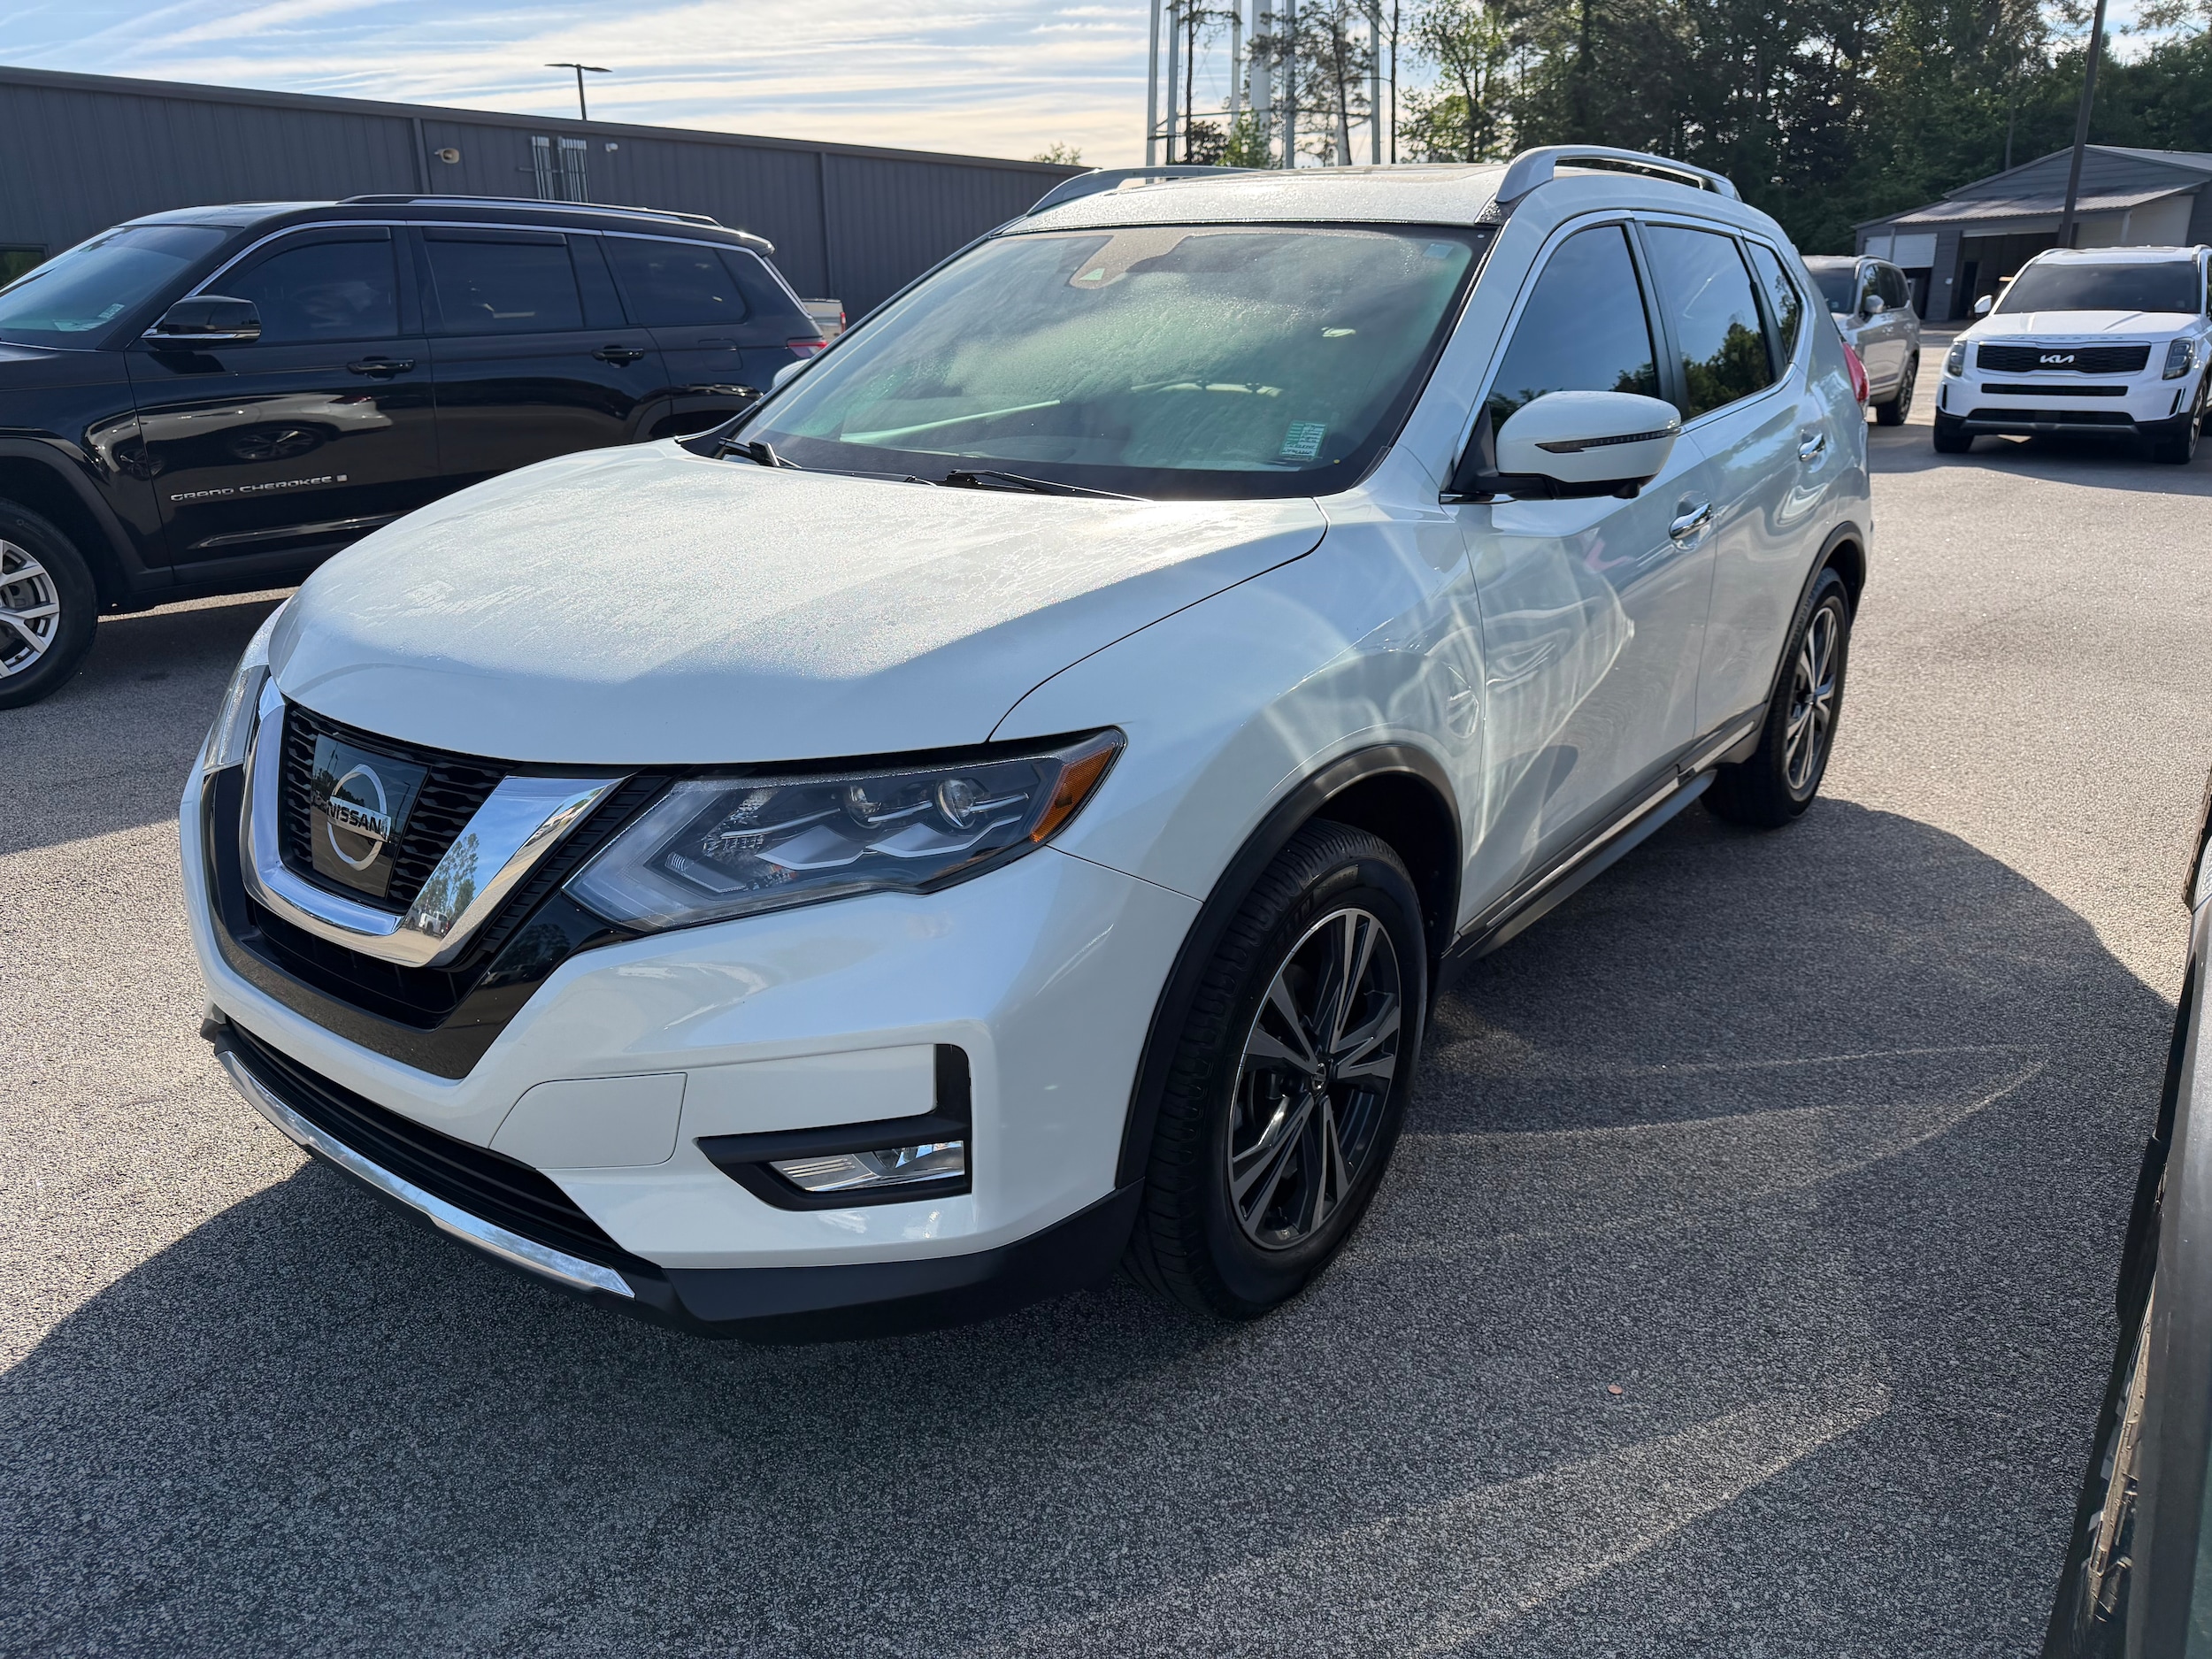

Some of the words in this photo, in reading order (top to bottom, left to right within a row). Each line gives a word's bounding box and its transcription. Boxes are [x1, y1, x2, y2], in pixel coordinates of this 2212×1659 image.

[2039, 354, 2076, 364] KIA
[170, 488, 234, 502] GRAND
[239, 475, 333, 493] CHEROKEE
[326, 800, 382, 835] NISSAN
